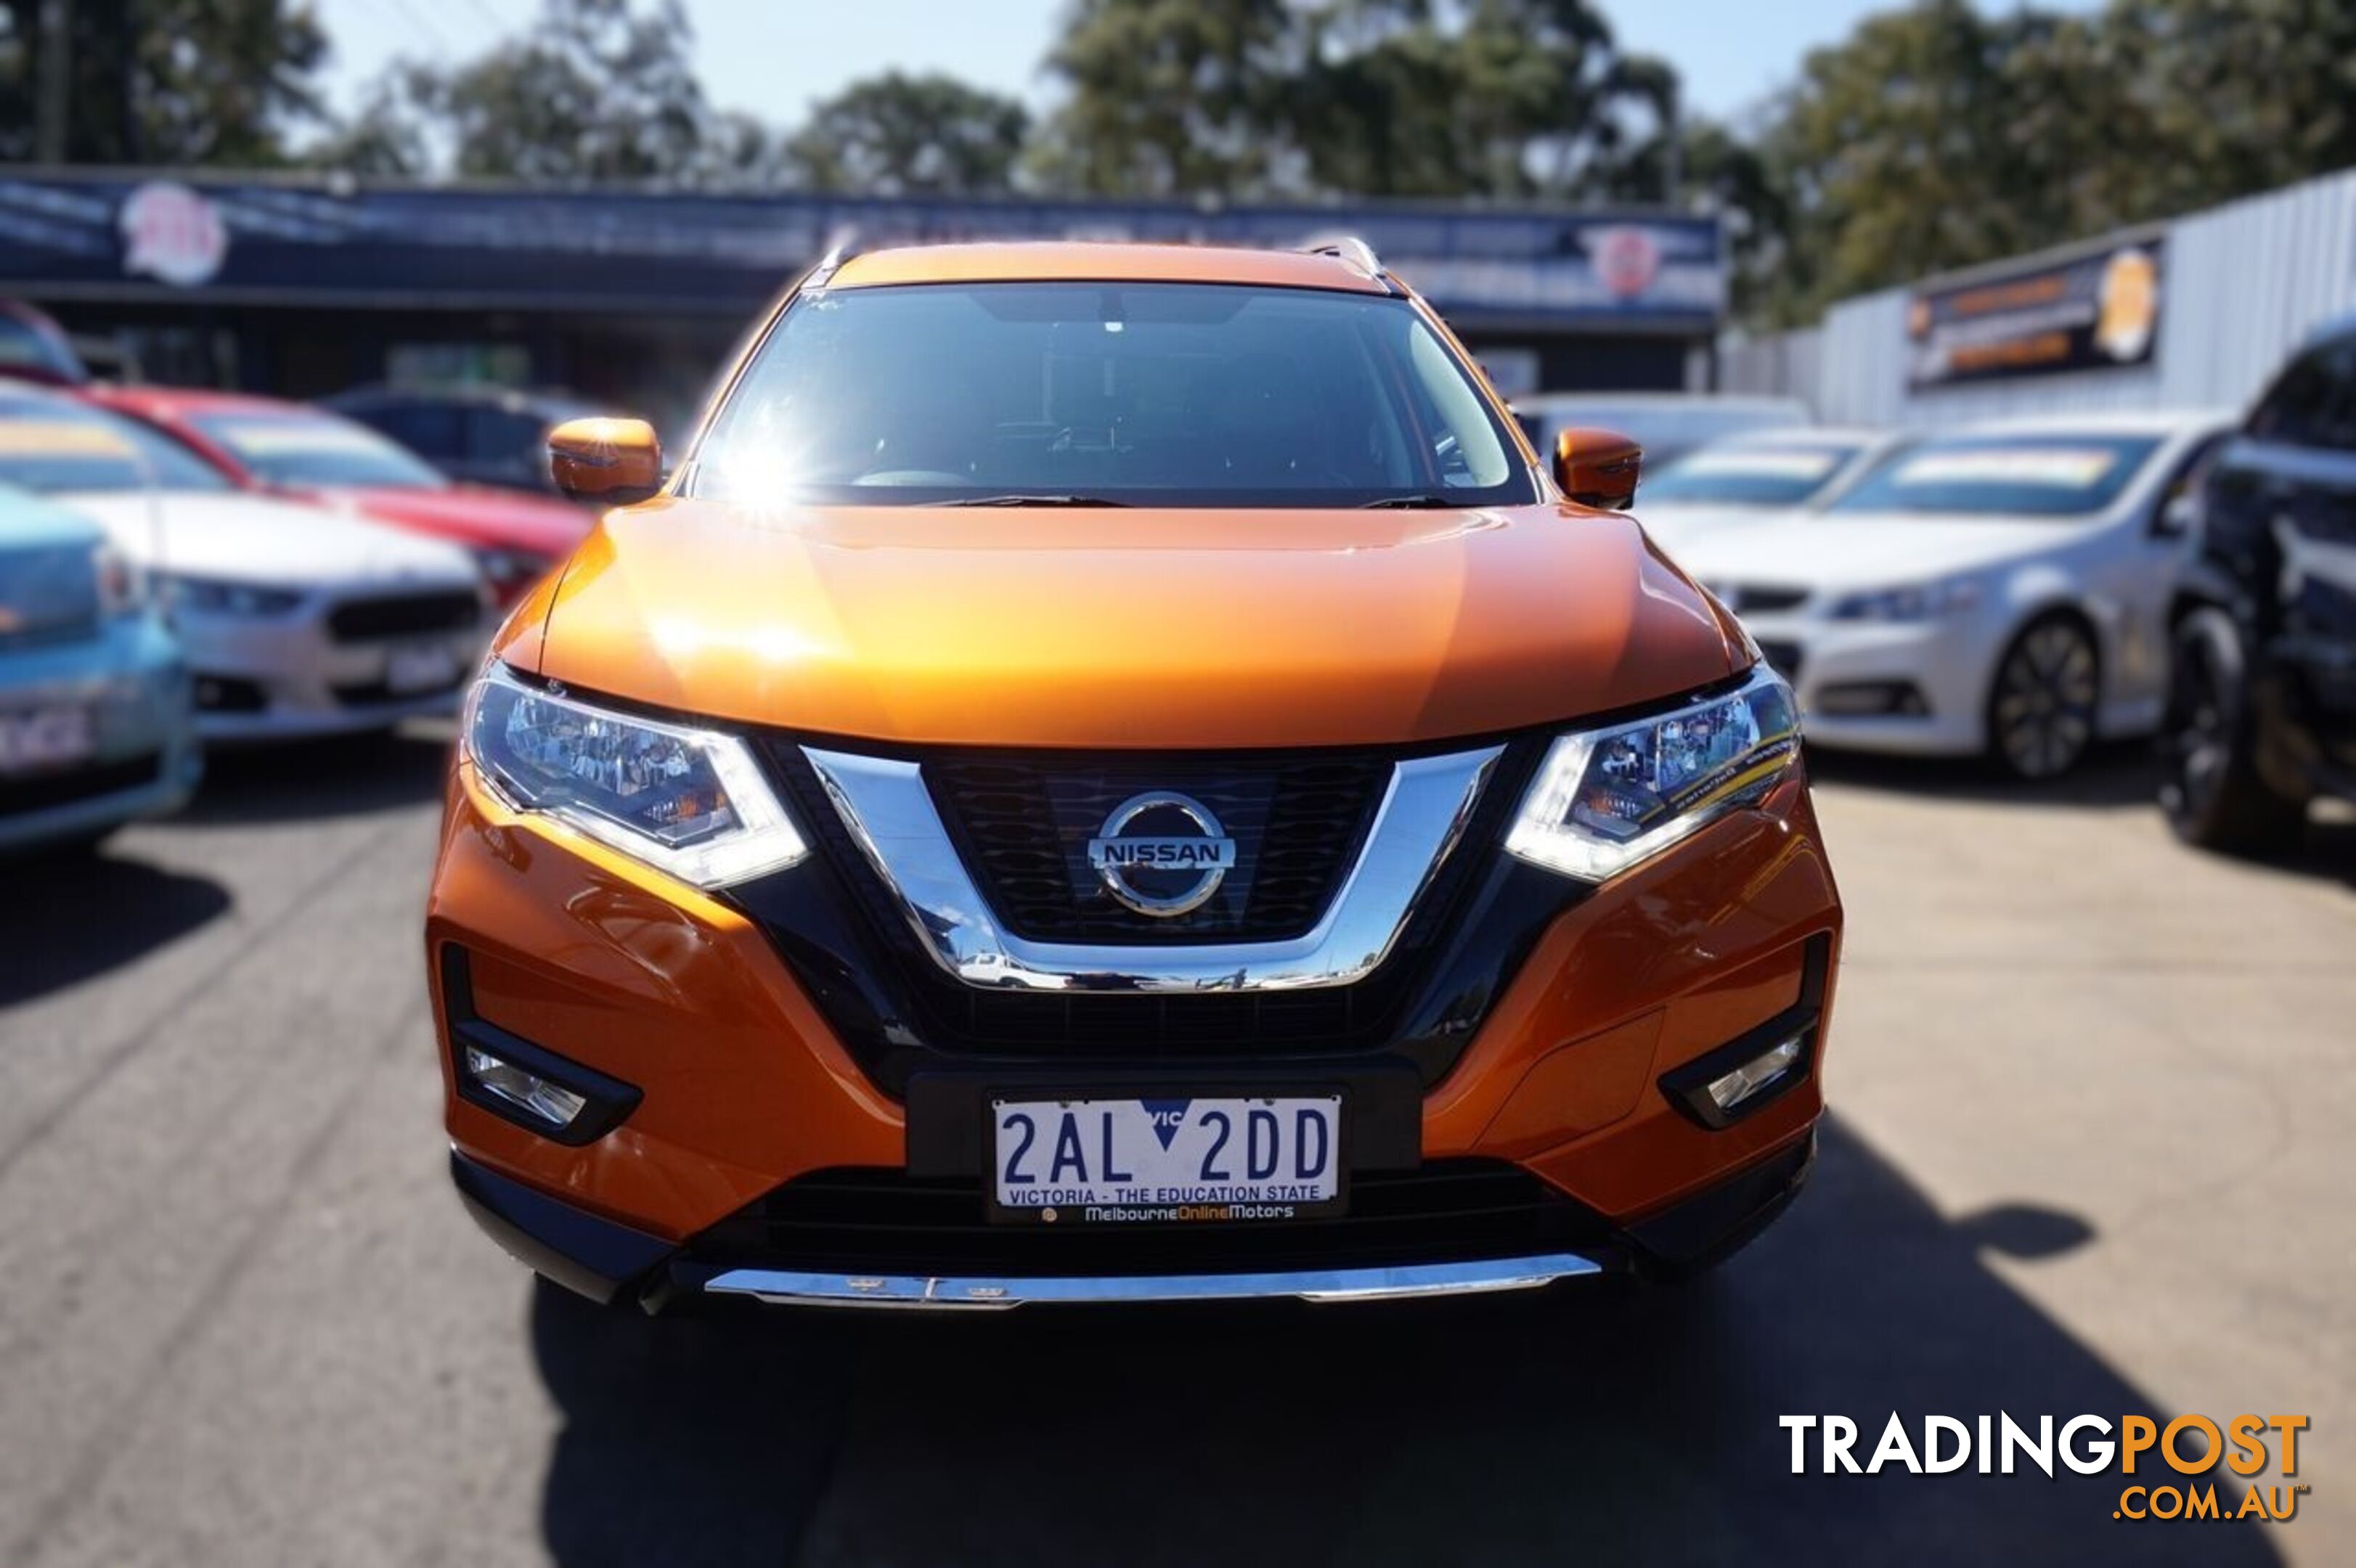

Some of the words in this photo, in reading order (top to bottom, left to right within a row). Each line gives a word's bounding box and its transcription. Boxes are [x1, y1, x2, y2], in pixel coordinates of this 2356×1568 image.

[1104, 844, 1220, 862] NISSAN
[1147, 1111, 1183, 1127] VIC
[1002, 1112, 1133, 1183] 2AL
[1199, 1108, 1328, 1181] 2DD
[1009, 1188, 1096, 1205] VICTORIA
[1115, 1188, 1149, 1203] THE
[1157, 1185, 1260, 1202] EDUCATION
[1266, 1185, 1320, 1201] STATE
